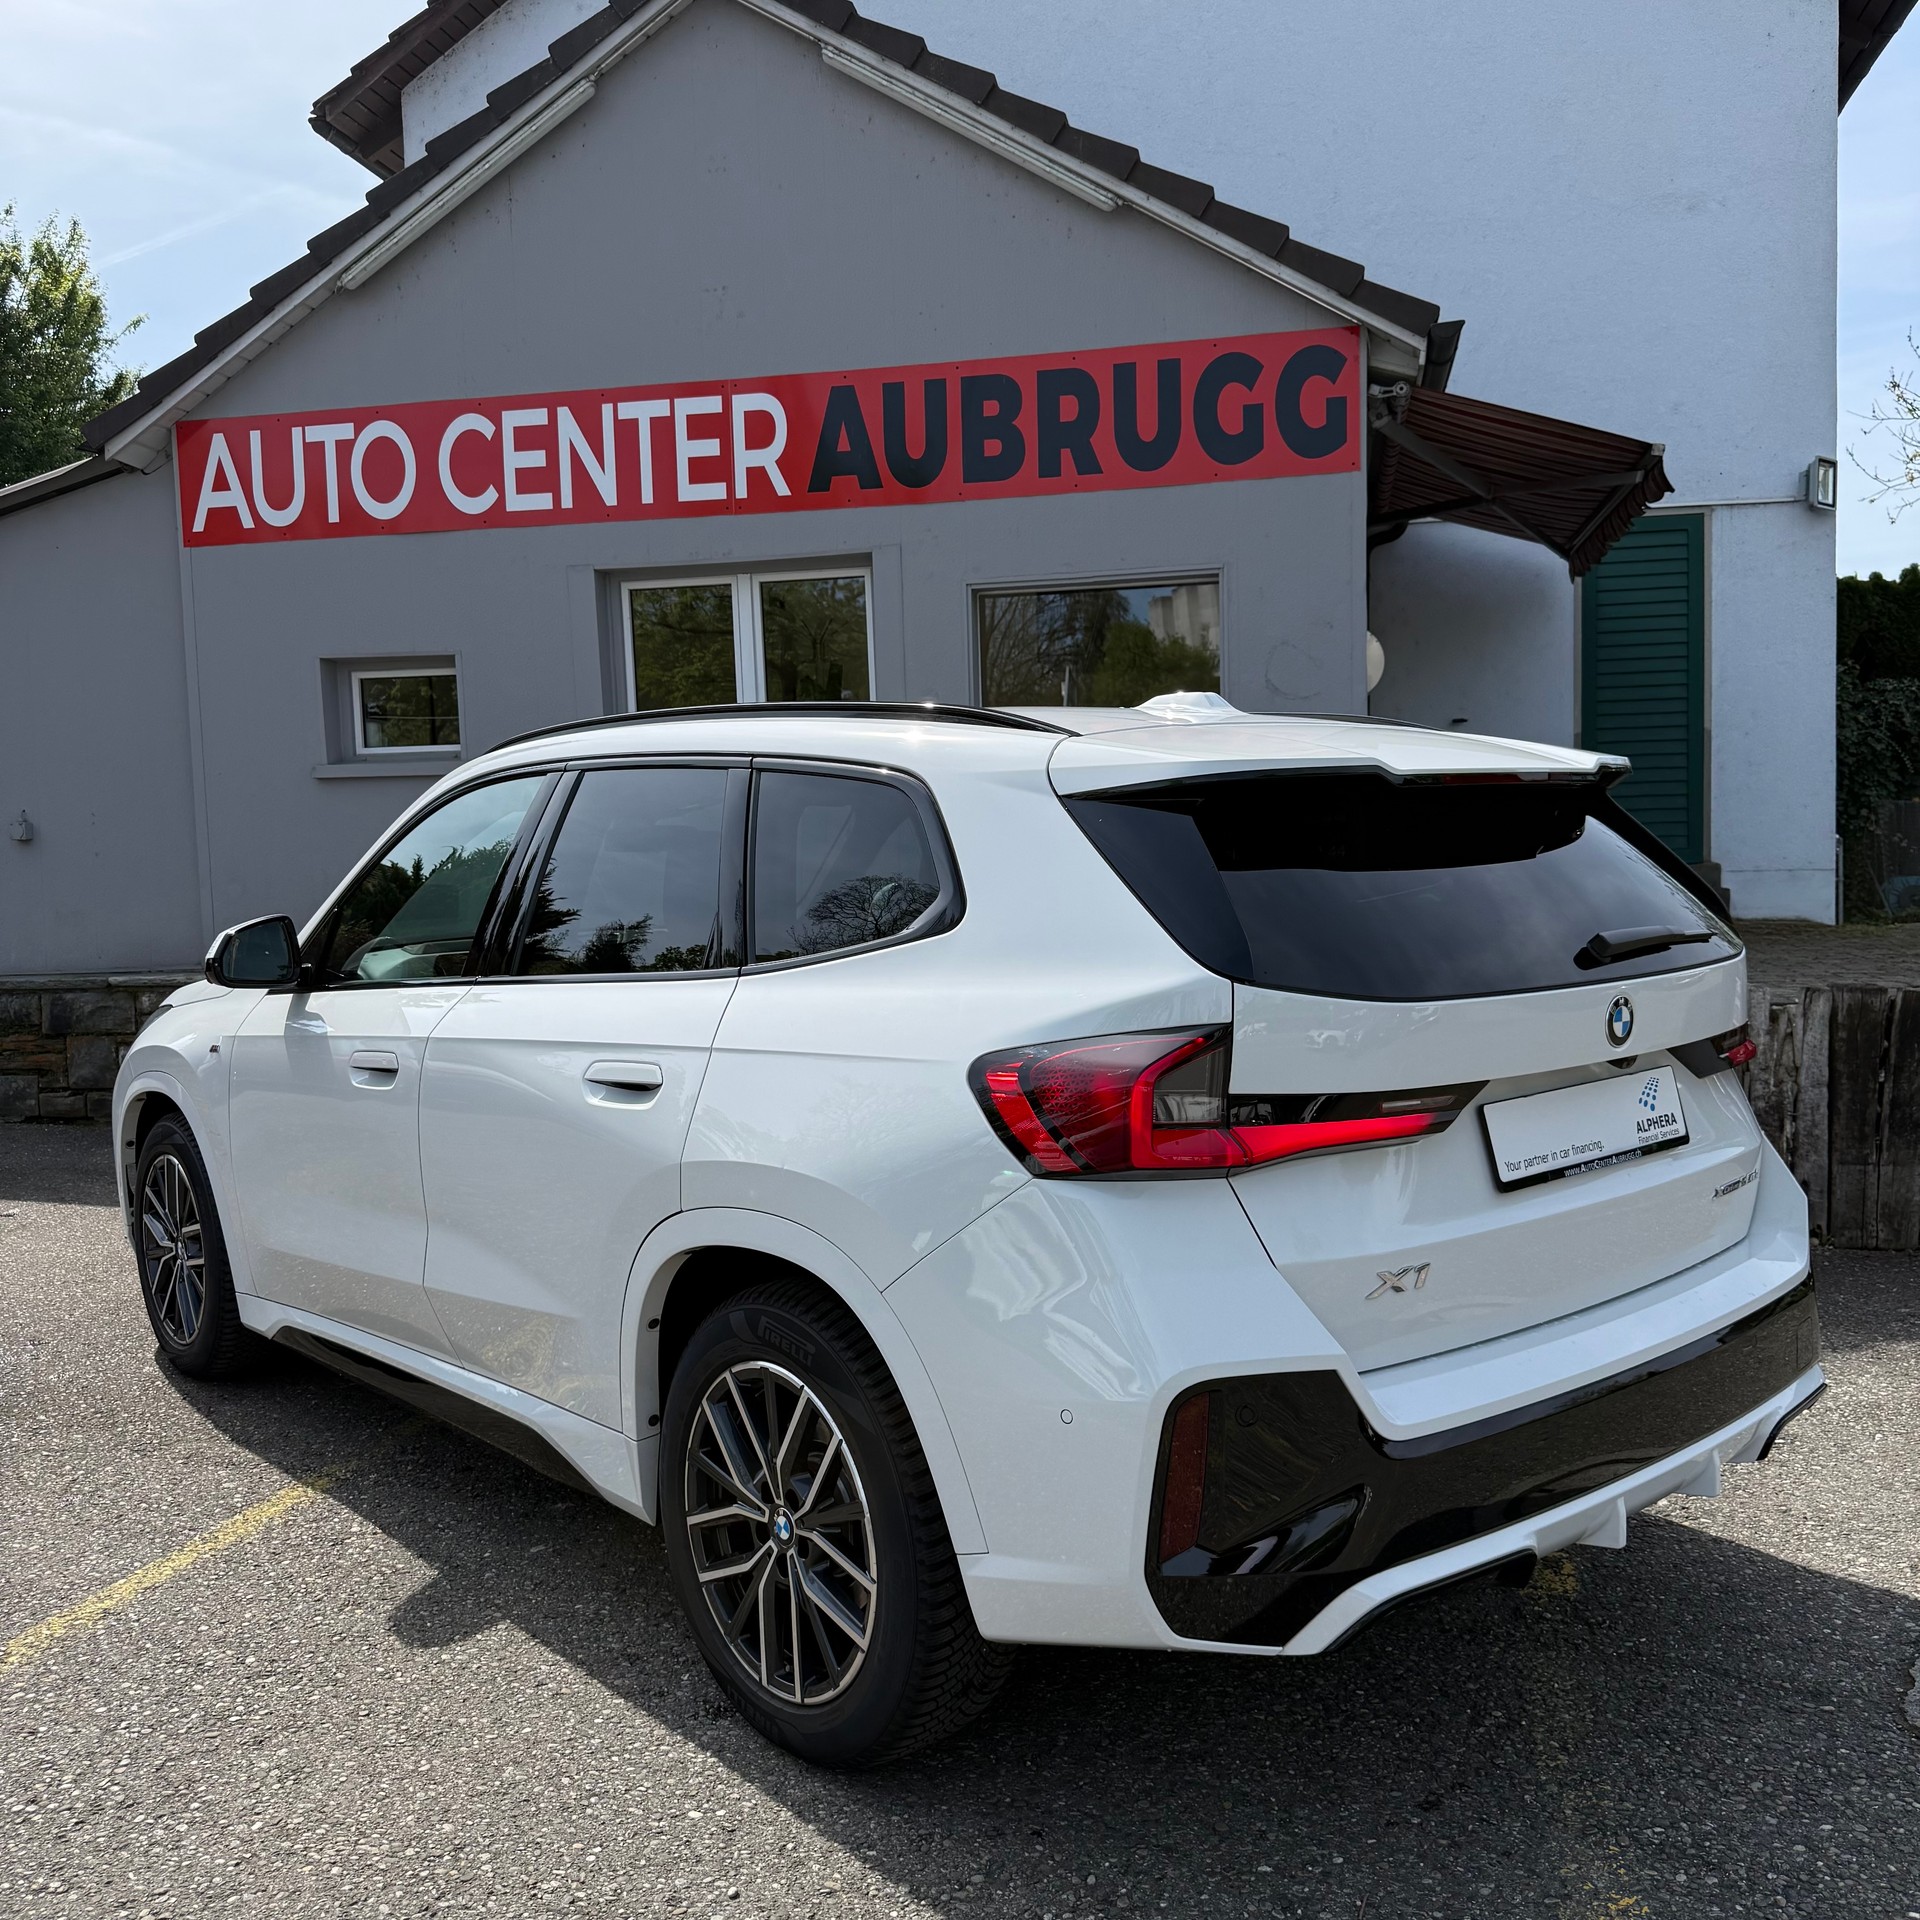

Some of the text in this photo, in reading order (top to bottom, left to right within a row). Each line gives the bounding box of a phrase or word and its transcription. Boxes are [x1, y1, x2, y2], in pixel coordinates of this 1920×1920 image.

[192, 344, 1349, 533] AUTO CENTER AUBRUGG
[1636, 1112, 1678, 1134] ALPHERA
[1638, 1127, 1680, 1145] Financial Services
[1504, 1139, 1605, 1173] Your partner in car financing.
[1365, 1262, 1431, 1300] X1
[757, 1314, 816, 1367] PIRELLI
